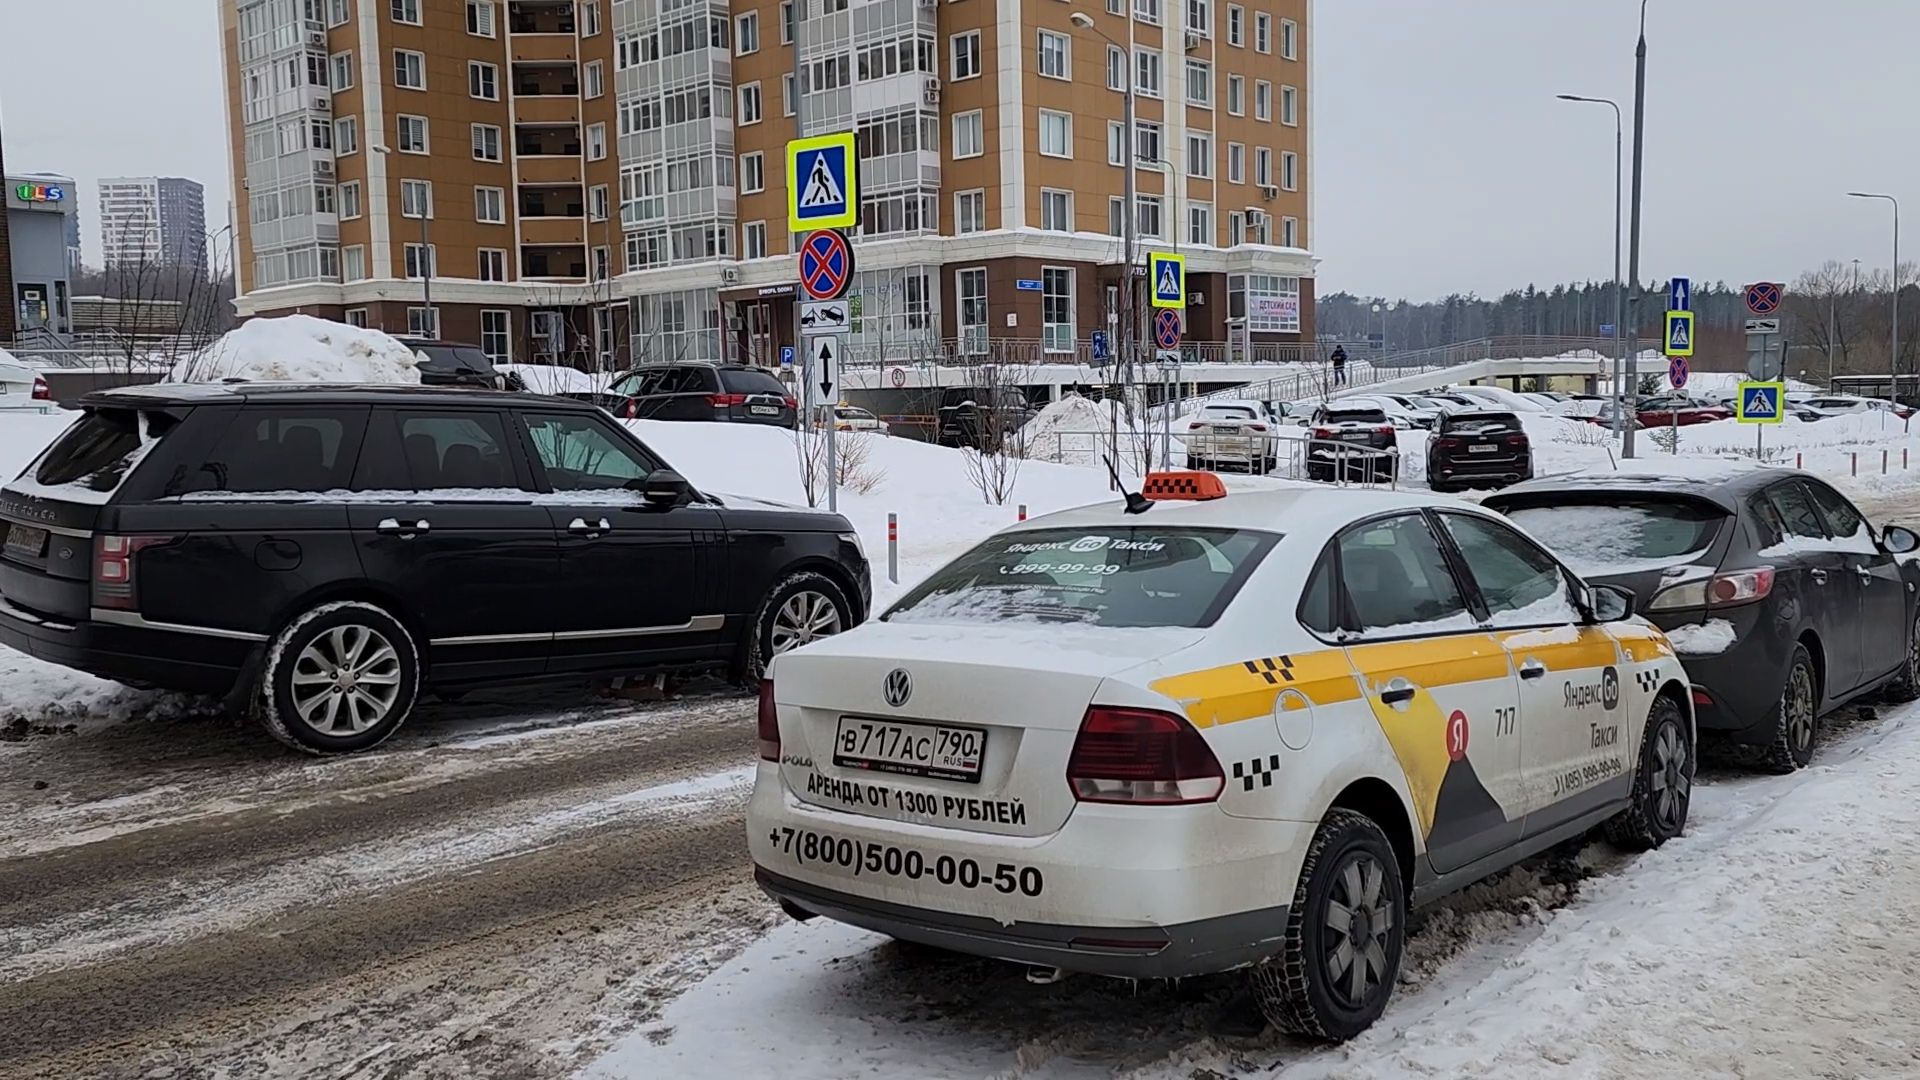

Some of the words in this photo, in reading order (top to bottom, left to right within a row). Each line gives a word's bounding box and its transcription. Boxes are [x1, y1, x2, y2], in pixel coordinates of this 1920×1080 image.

[1003, 541, 1071, 553] Яндекс
[1109, 539, 1166, 552] Такси
[1009, 563, 1121, 575] 999-99-99
[1564, 680, 1602, 709] Яндекс
[1495, 707, 1516, 737] 717
[1590, 723, 1618, 749] Такси
[782, 755, 813, 768] POLO
[943, 755, 962, 767] RUS
[1561, 770, 1584, 794] (495)
[807, 773, 864, 806] АРЕНДА
[867, 786, 889, 808] ОТ
[896, 789, 938, 816] 1300
[943, 796, 1027, 826] РУБЛЕЙ
[769, 826, 1044, 897] +7(800)500-00-50
